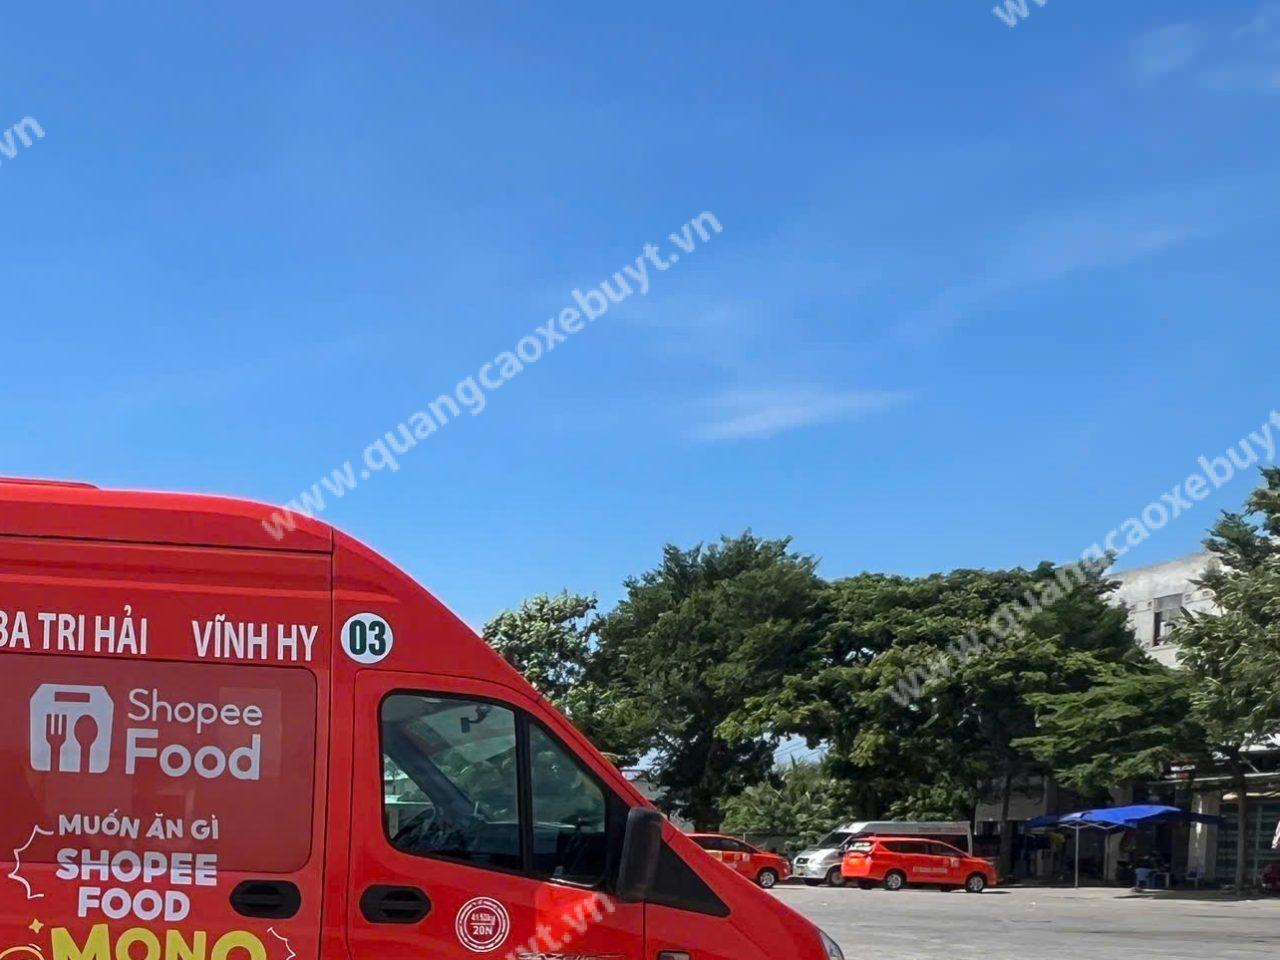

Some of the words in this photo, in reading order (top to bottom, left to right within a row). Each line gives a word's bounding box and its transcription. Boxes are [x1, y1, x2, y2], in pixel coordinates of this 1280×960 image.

[38, 612, 85, 652] TRI
[94, 605, 148, 655] HẢI
[192, 614, 268, 660] VĨNH
[277, 622, 319, 661] HY
[349, 618, 387, 657] 03
[128, 688, 262, 733] Shopee
[125, 727, 261, 780] Food
[58, 809, 140, 840] MUỐN
[191, 814, 219, 840] GÌ
[56, 848, 217, 886] SHOPEE
[78, 886, 190, 921] FOOD
